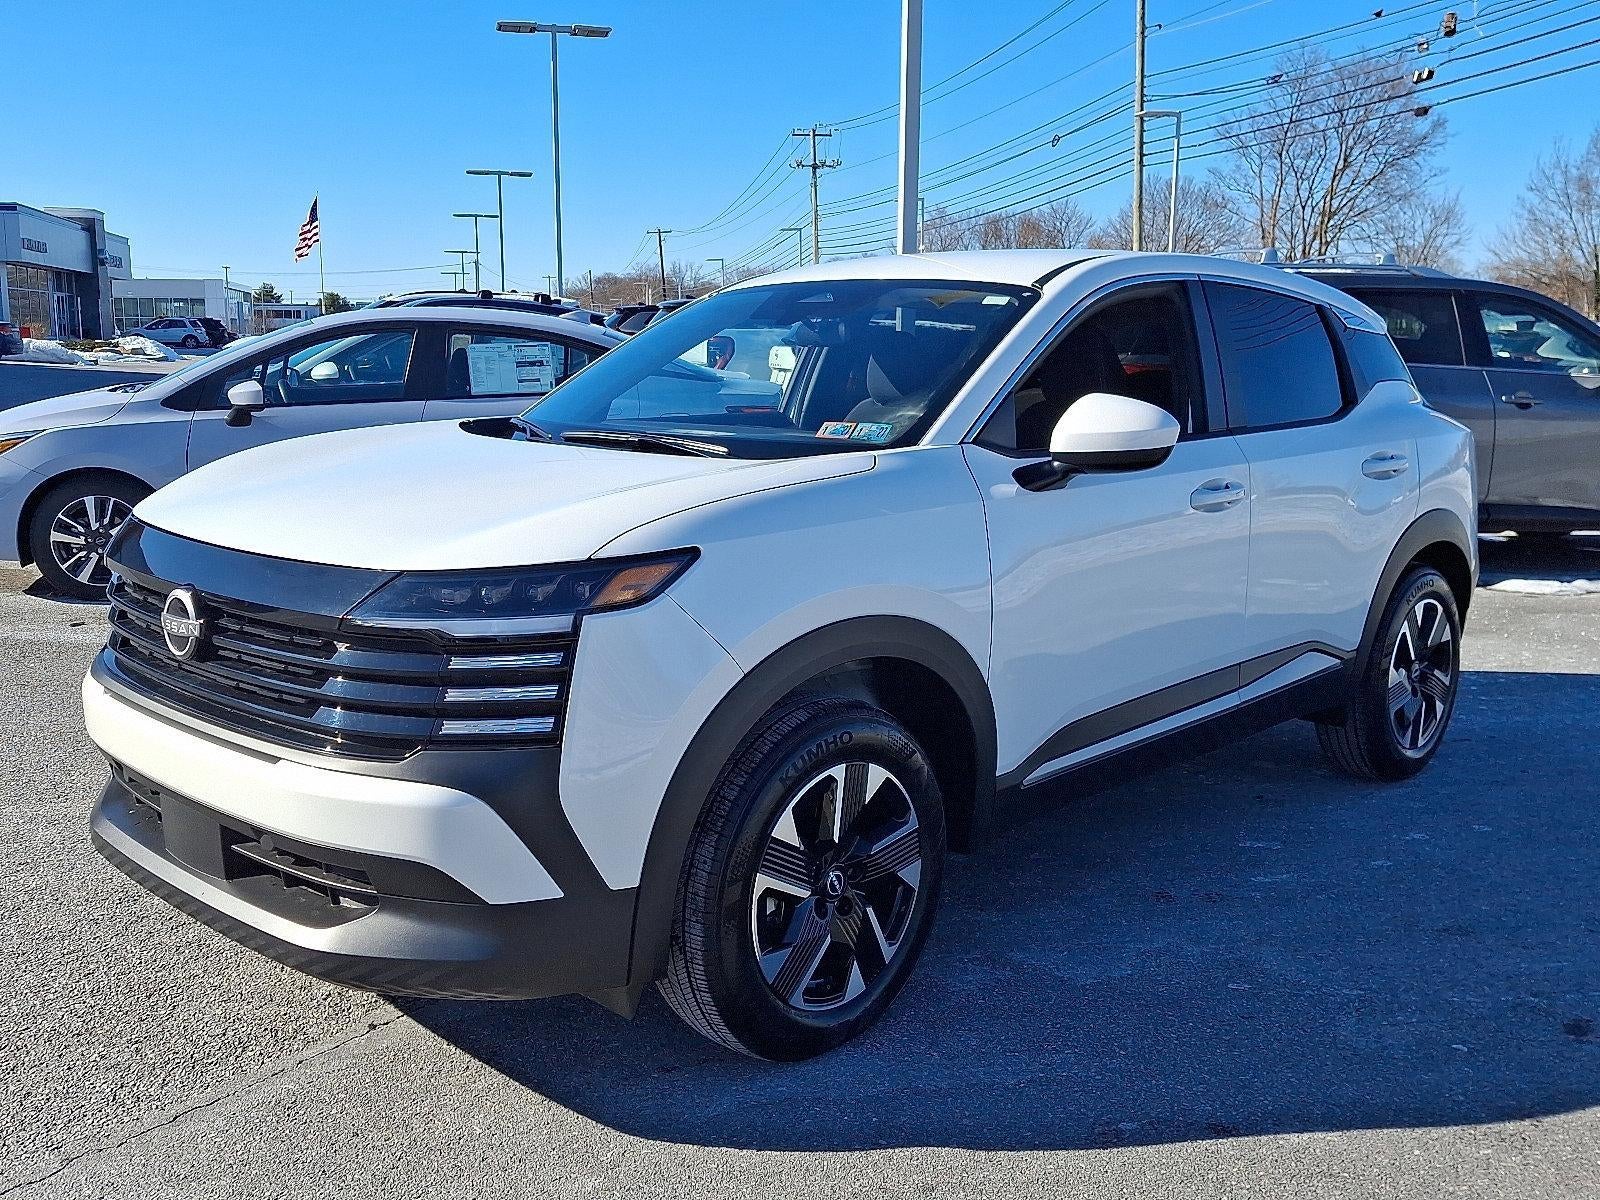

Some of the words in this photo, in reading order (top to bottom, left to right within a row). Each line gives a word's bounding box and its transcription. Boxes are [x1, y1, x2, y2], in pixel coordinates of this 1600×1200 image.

[1406, 579, 1435, 606] KUMHO
[162, 618, 198, 636] SSAN
[779, 730, 854, 783] KUMHO
